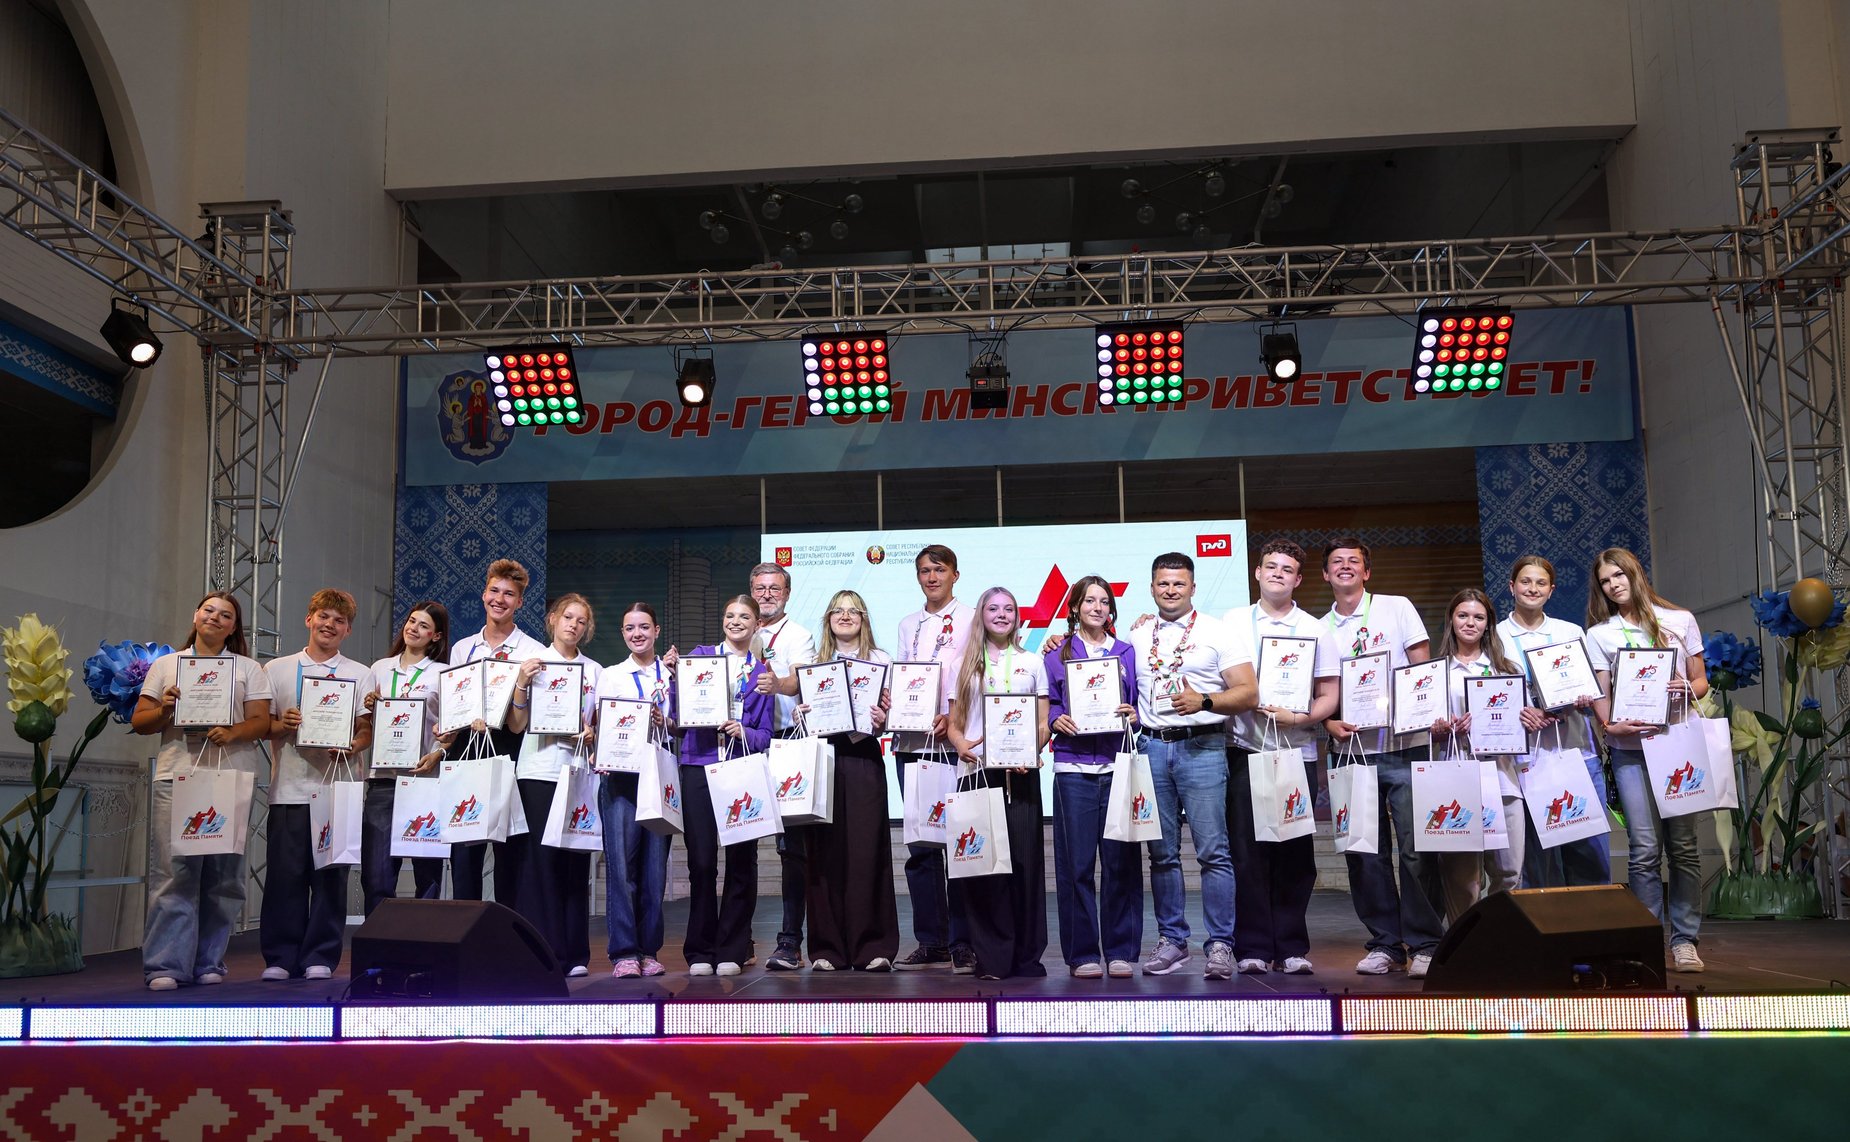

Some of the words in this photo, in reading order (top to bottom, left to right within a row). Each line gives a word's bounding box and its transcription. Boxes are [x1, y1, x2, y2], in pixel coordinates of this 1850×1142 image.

[909, 694, 918, 702] III
[1417, 693, 1427, 701] III
[618, 732, 628, 740] III
[1664, 793, 1684, 801] Поезд
[1684, 789, 1705, 797] Памяти
[743, 817, 764, 826] Памяти
[927, 821, 941, 829] Поезд
[1546, 822, 1566, 831] Поезд
[1565, 816, 1590, 826] Памяти
